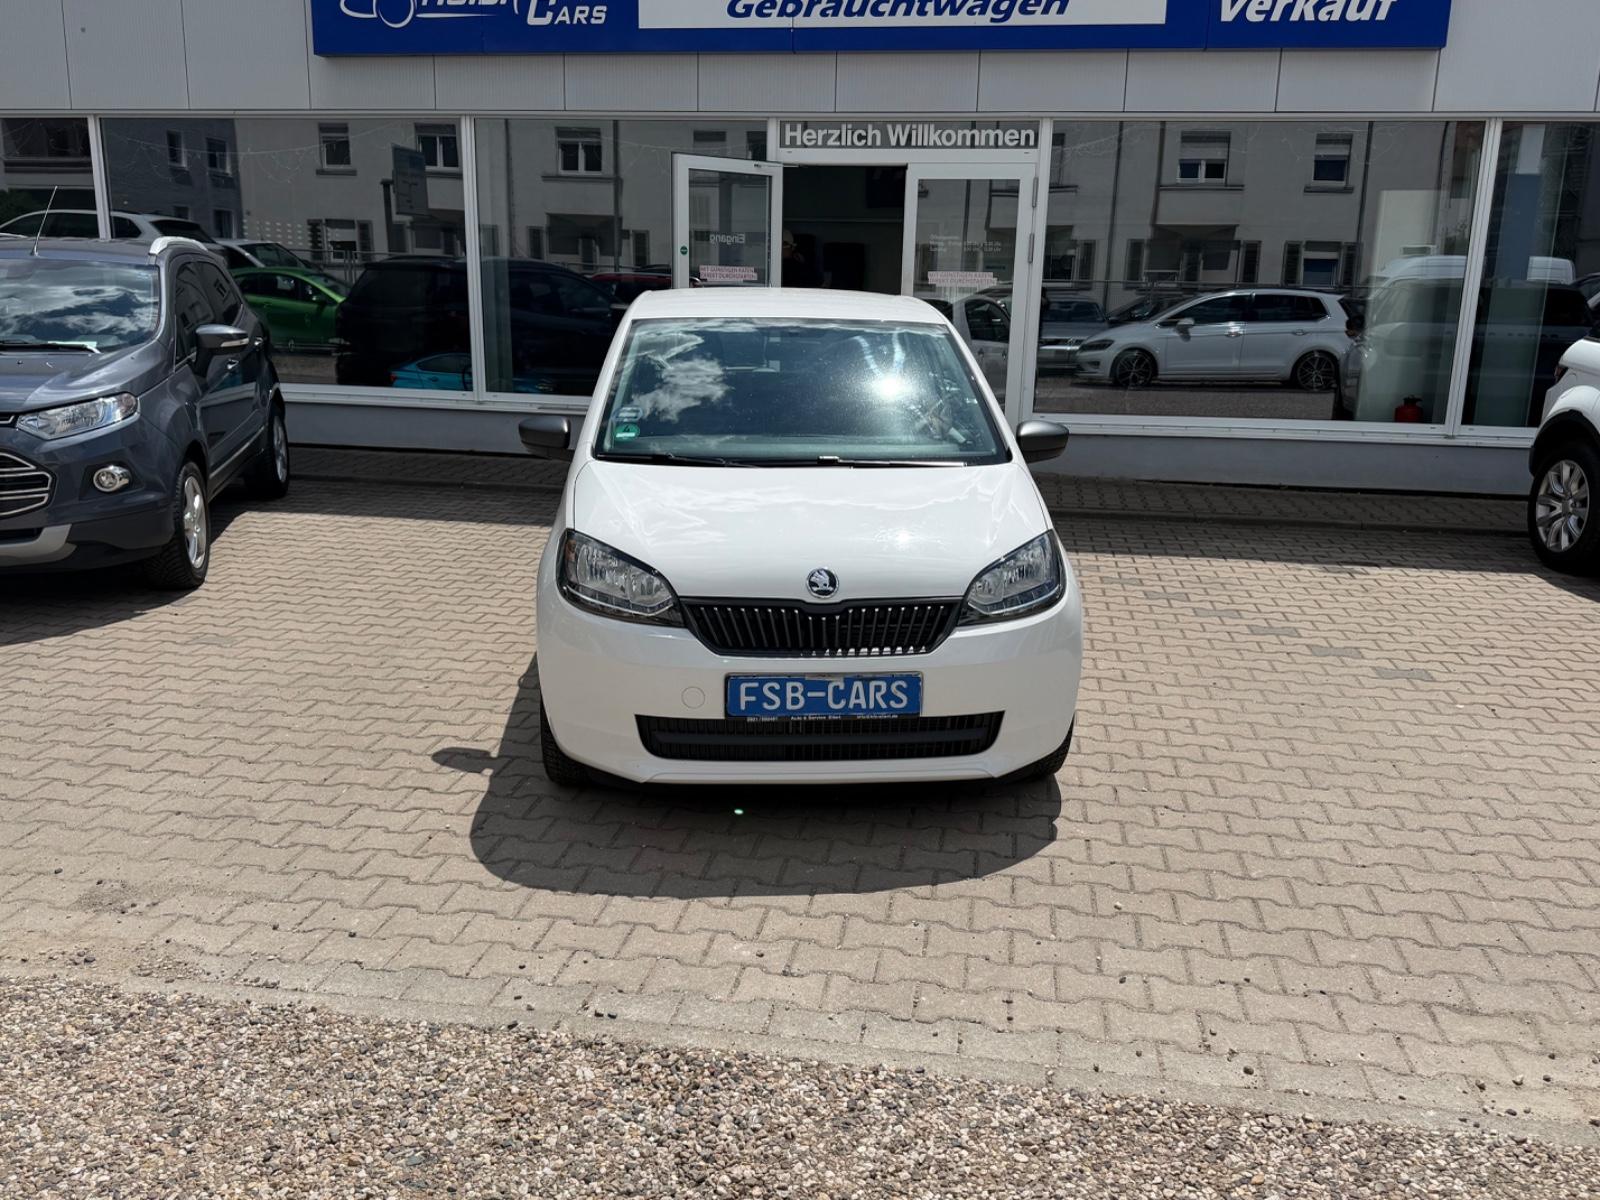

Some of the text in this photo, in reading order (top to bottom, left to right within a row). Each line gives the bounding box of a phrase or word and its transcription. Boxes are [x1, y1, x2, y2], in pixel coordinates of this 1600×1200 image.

[726, 0, 1068, 24] Gebrauchtwagen
[1220, 0, 1396, 22] Verkauf
[784, 123, 1035, 147] Herzlich Willkommen
[739, 680, 909, 711] FSB-CARS
